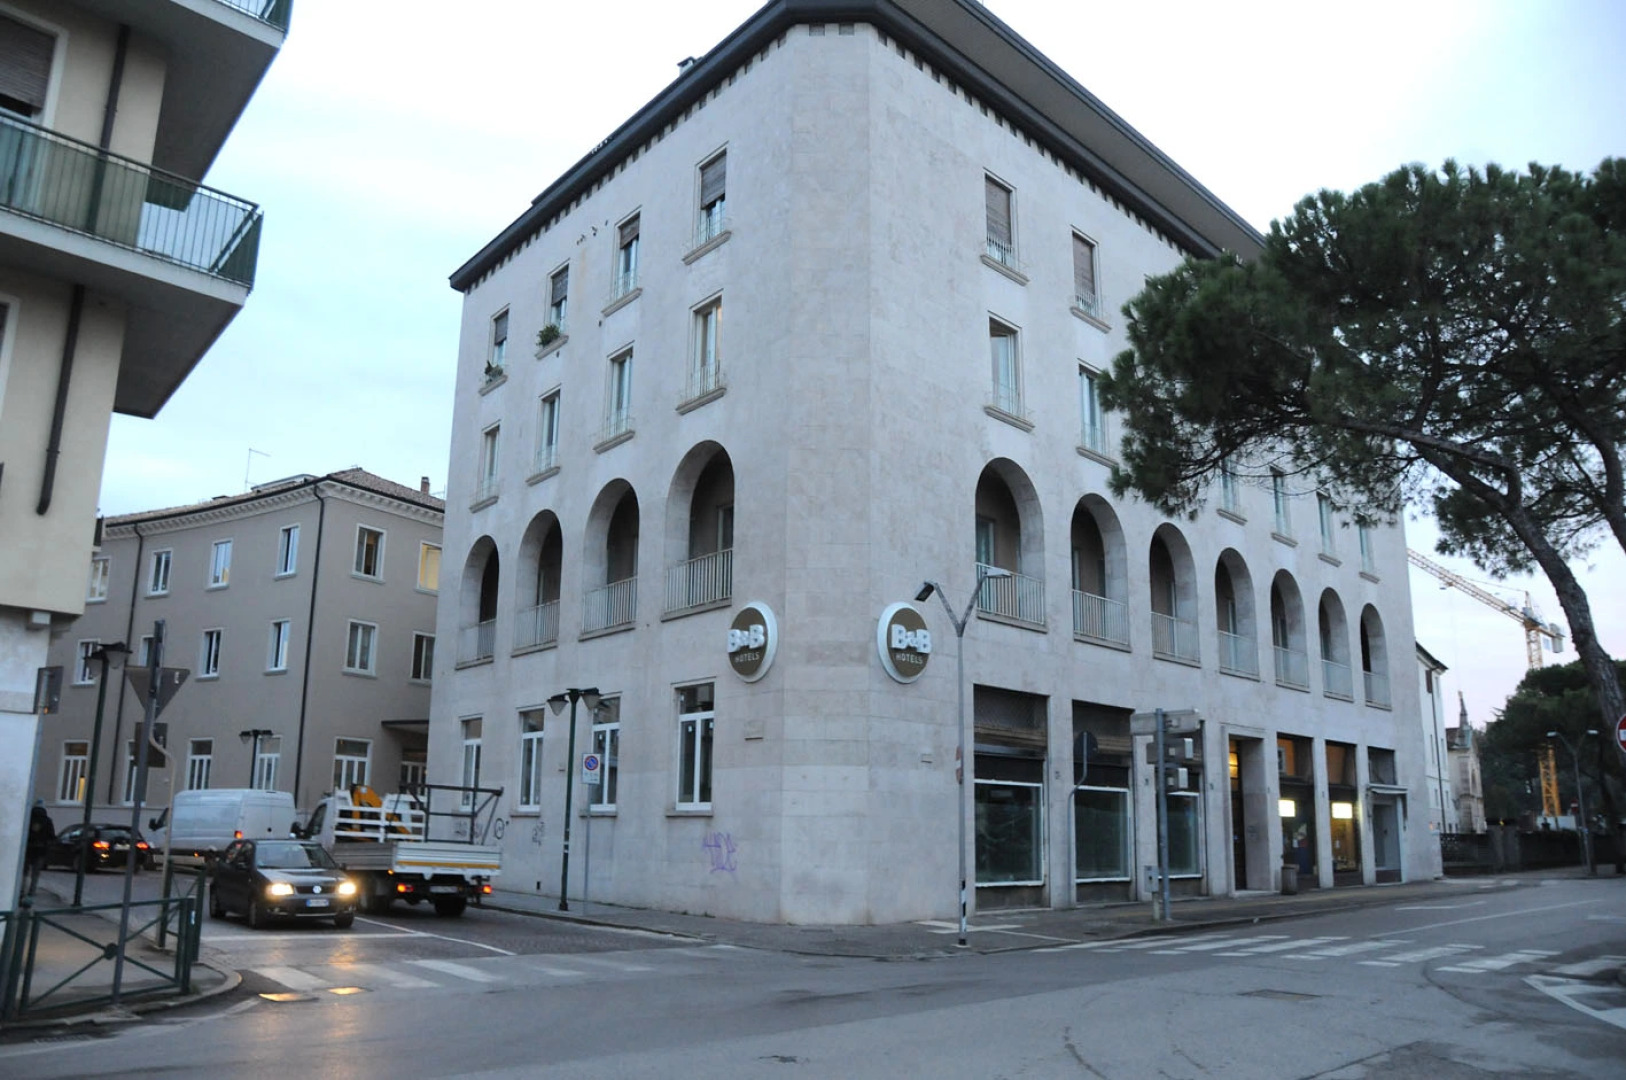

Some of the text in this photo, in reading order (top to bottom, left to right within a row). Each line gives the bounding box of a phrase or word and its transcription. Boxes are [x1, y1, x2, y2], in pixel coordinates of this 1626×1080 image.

[728, 625, 765, 652] B&B
[892, 624, 932, 653] B&B
[735, 652, 760, 662] HOTELS
[895, 653, 924, 664] HOTELS
